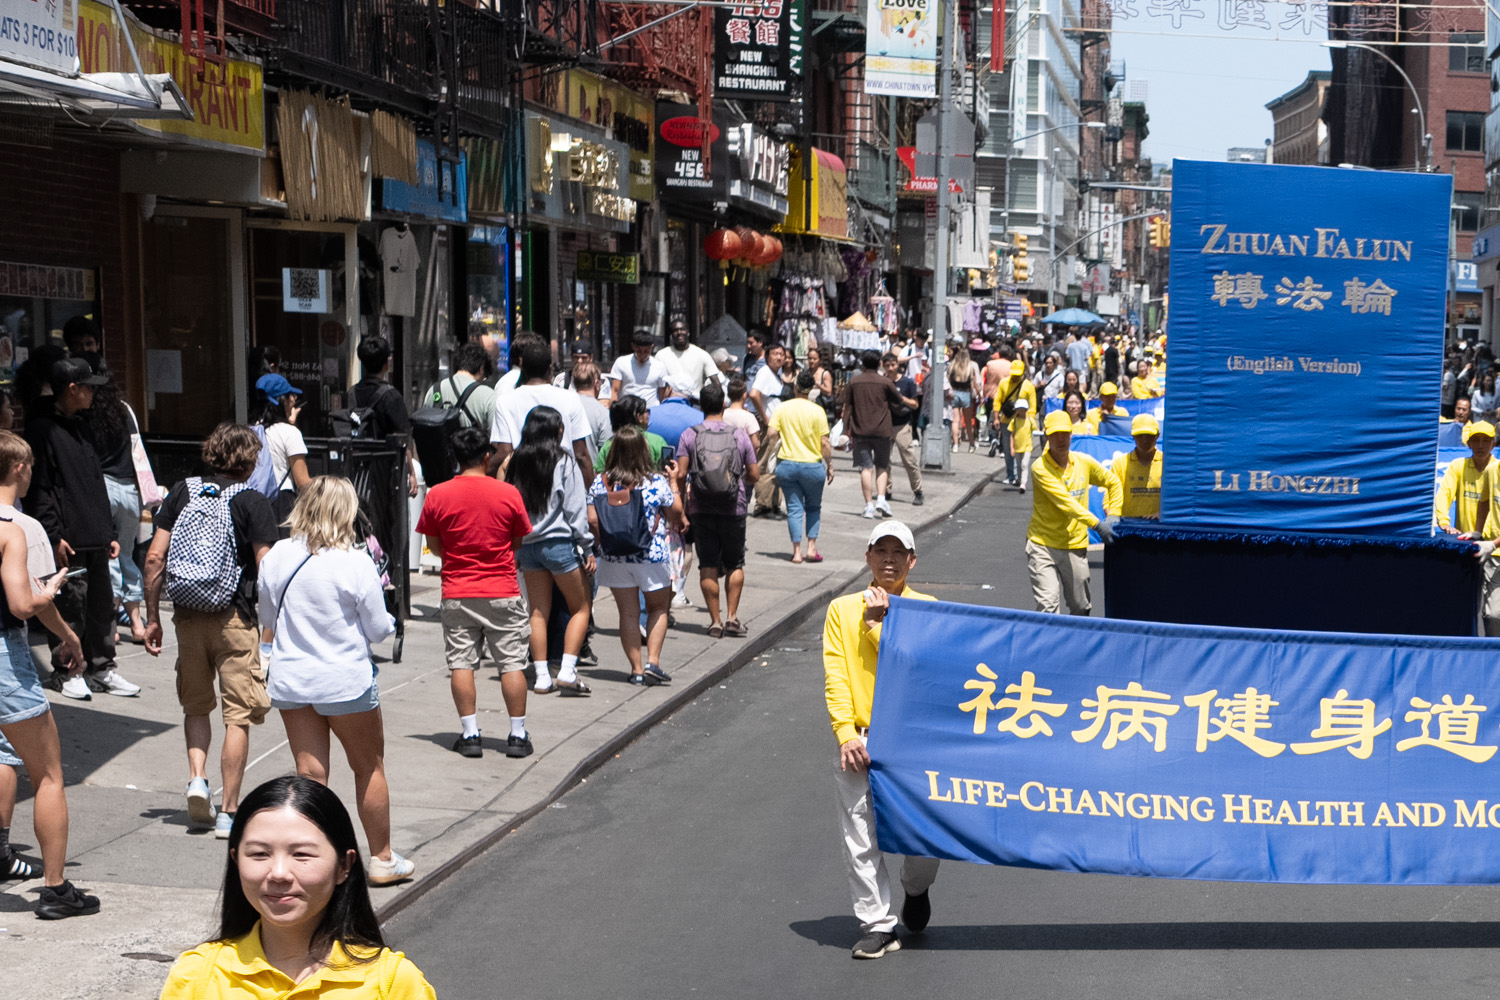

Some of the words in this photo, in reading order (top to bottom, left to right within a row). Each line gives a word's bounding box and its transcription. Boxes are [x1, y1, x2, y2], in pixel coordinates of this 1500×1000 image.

[23, 20, 29, 45] 3
[32, 23, 55, 51] FOR
[57, 30, 75, 58] $10
[725, 18, 780, 46] 餐館
[740, 50, 762, 62] NEW
[725, 63, 777, 77] SHANGHAI
[718, 77, 786, 92] RESTAURANT
[681, 149, 700, 162] NEW
[674, 161, 705, 178] 456
[1211, 270, 1398, 316] 轉法輪
[1226, 355, 1294, 376] (English
[1298, 356, 1362, 377] Version)
[1248, 470, 1360, 495] HONGZHI
[926, 769, 1215, 824] LIFE-CHANGING
[1222, 790, 1366, 828] HEALTH
[1372, 799, 1447, 829] AND
